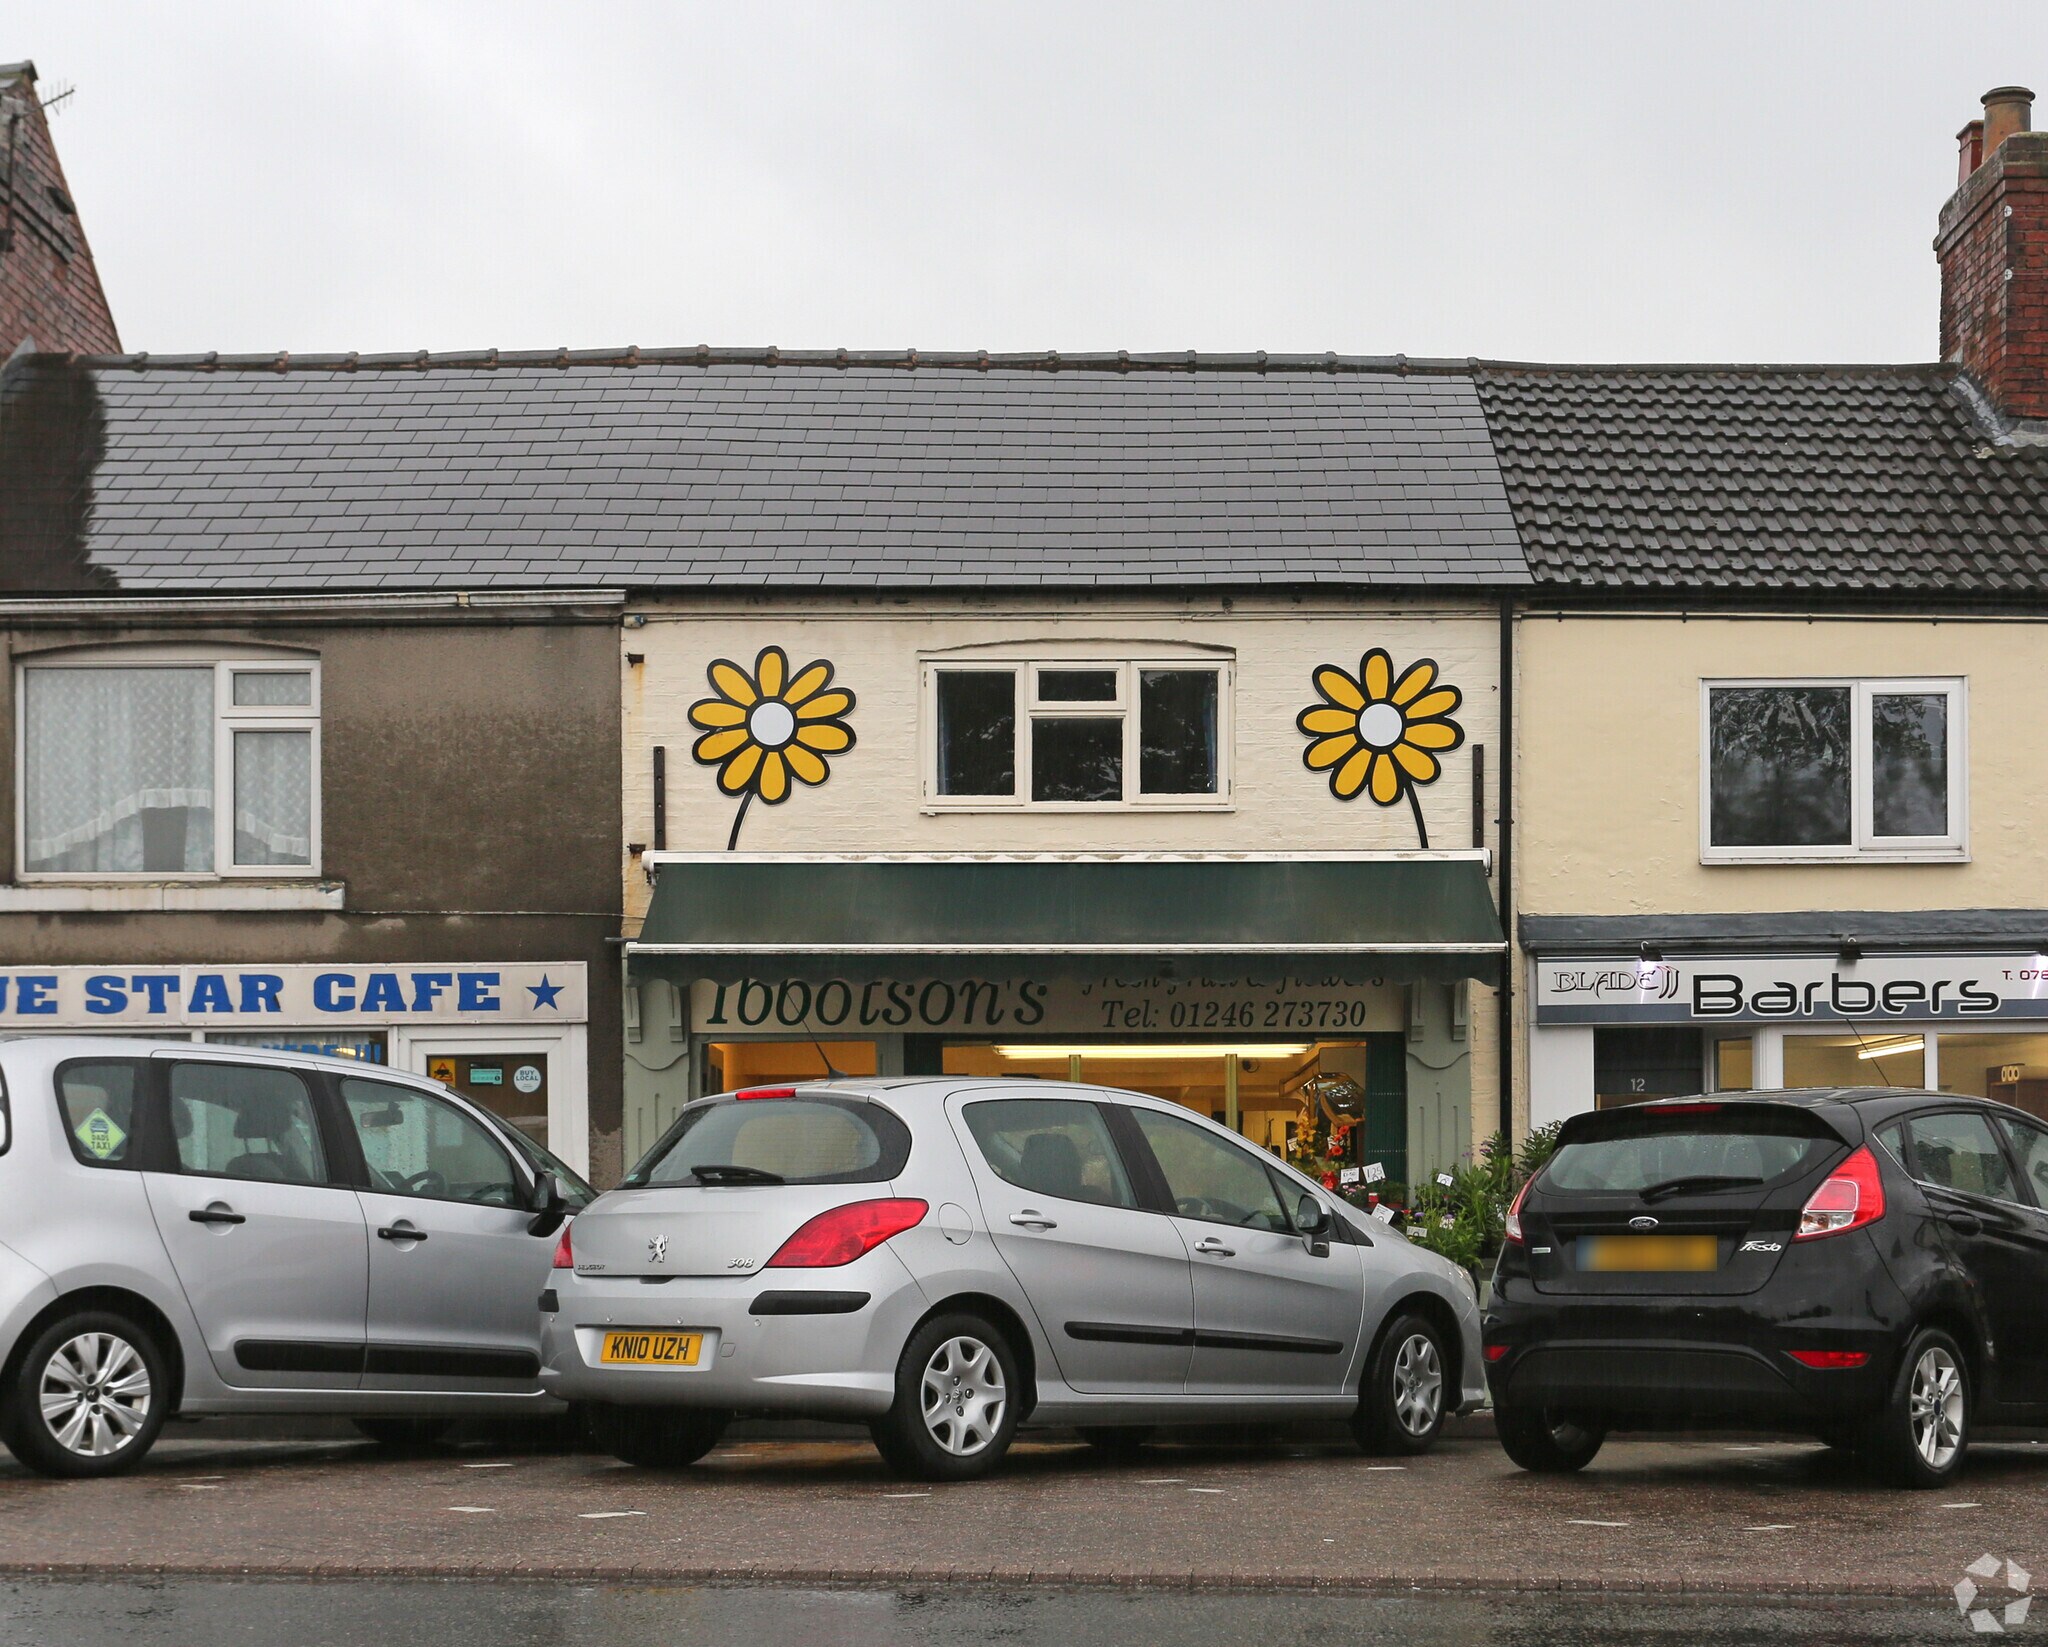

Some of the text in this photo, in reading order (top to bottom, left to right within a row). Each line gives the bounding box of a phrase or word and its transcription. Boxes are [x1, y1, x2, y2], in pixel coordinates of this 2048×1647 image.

[2002, 970, 2013, 980] T.
[0, 973, 500, 1014] E STAR CAFE
[1693, 972, 2000, 1015] Barbers
[1101, 1000, 1366, 1027] Tel: 01246 273730
[1630, 1078, 1645, 1091] 12
[91, 1141, 111, 1150] TAXI
[727, 1257, 755, 1268] 308
[610, 1336, 690, 1360] KN10 UZH
